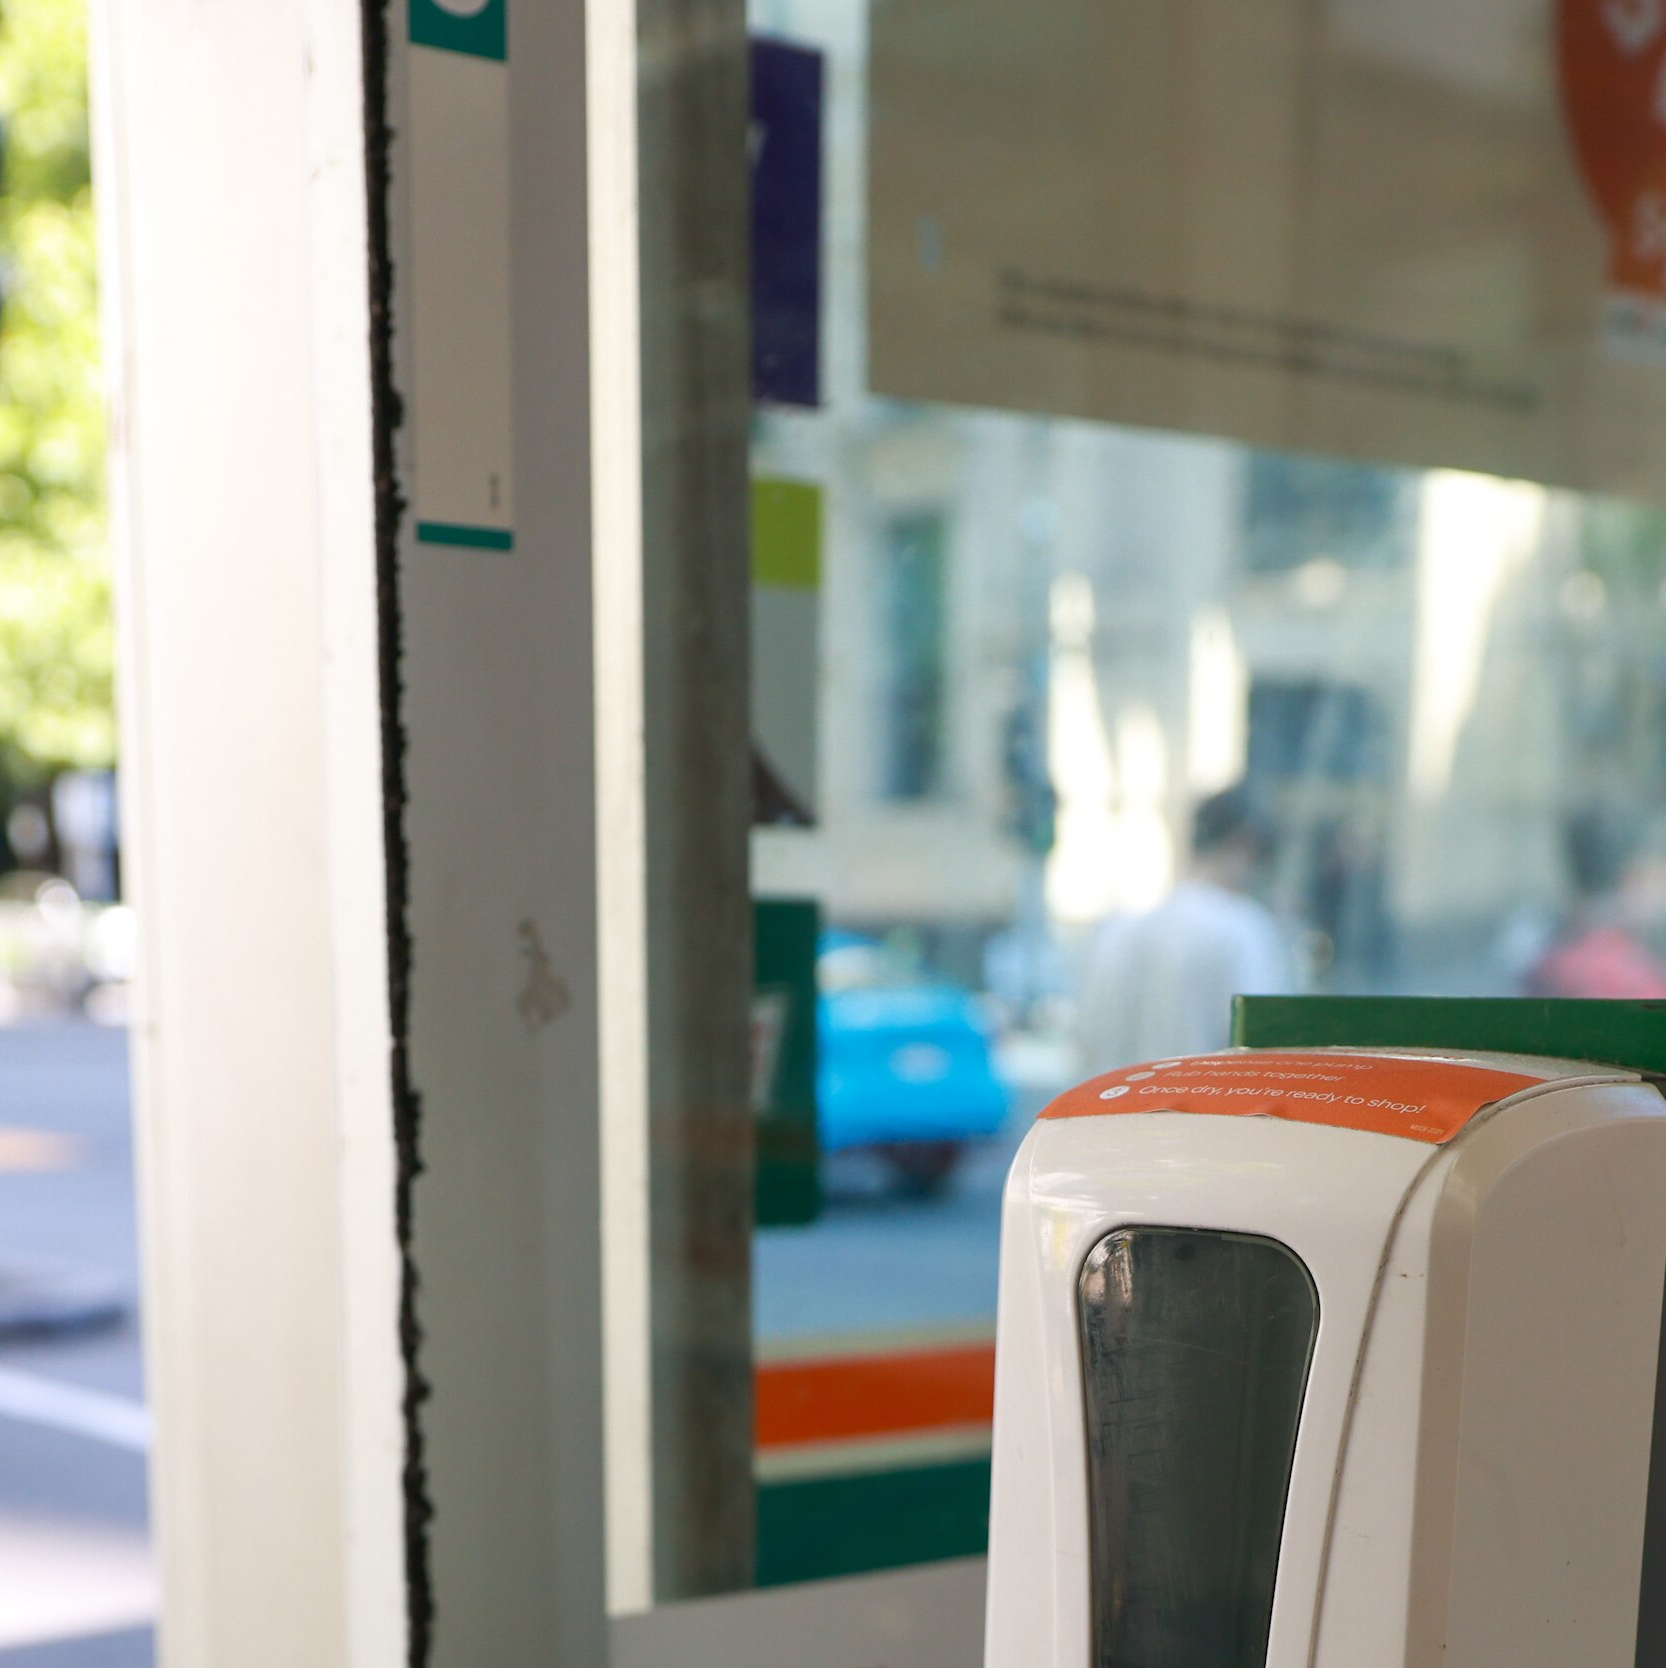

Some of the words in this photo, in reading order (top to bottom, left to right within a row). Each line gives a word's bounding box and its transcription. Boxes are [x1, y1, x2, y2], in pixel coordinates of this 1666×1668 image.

[1204, 1069, 1260, 1078] hands
[1263, 1070, 1347, 1083] together
[1139, 1084, 1188, 1095] Once
[1191, 1084, 1221, 1096] dry,
[1224, 1086, 1284, 1097] you're
[1286, 1088, 1343, 1104] ready
[1344, 1095, 1365, 1105] to
[1367, 1098, 1427, 1114] shop!
